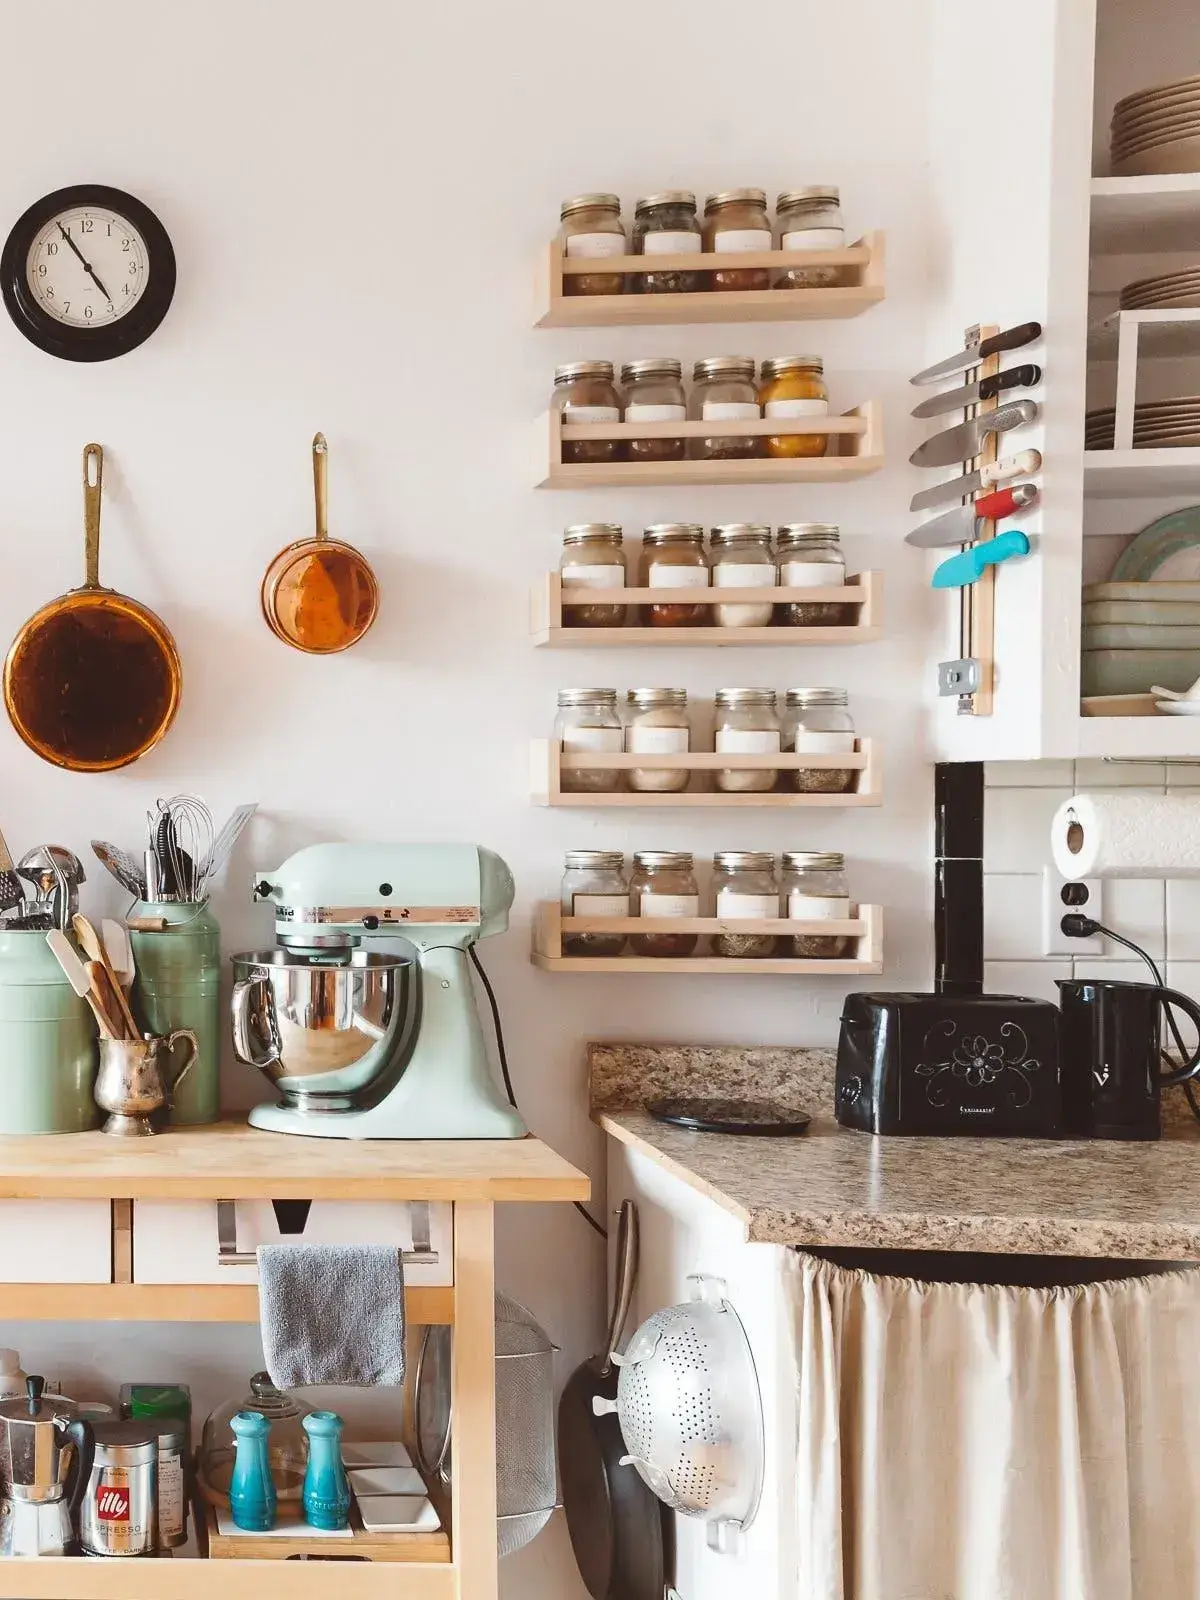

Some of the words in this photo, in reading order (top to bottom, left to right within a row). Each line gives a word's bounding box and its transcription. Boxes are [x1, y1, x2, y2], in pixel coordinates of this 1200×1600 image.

[81, 220, 93, 233] 12
[107, 224, 112, 237] 1
[47, 243, 58, 256] 10
[122, 239, 130, 252] 2
[39, 264, 47, 278] 9
[128, 262, 137, 274] 3
[46, 286, 54, 299] 8
[121, 283, 131, 295] 4
[63, 301, 71, 313] 7
[84, 305, 93, 318] 6
[107, 300, 114, 313] 5
[100, 1491, 128, 1519] illy
